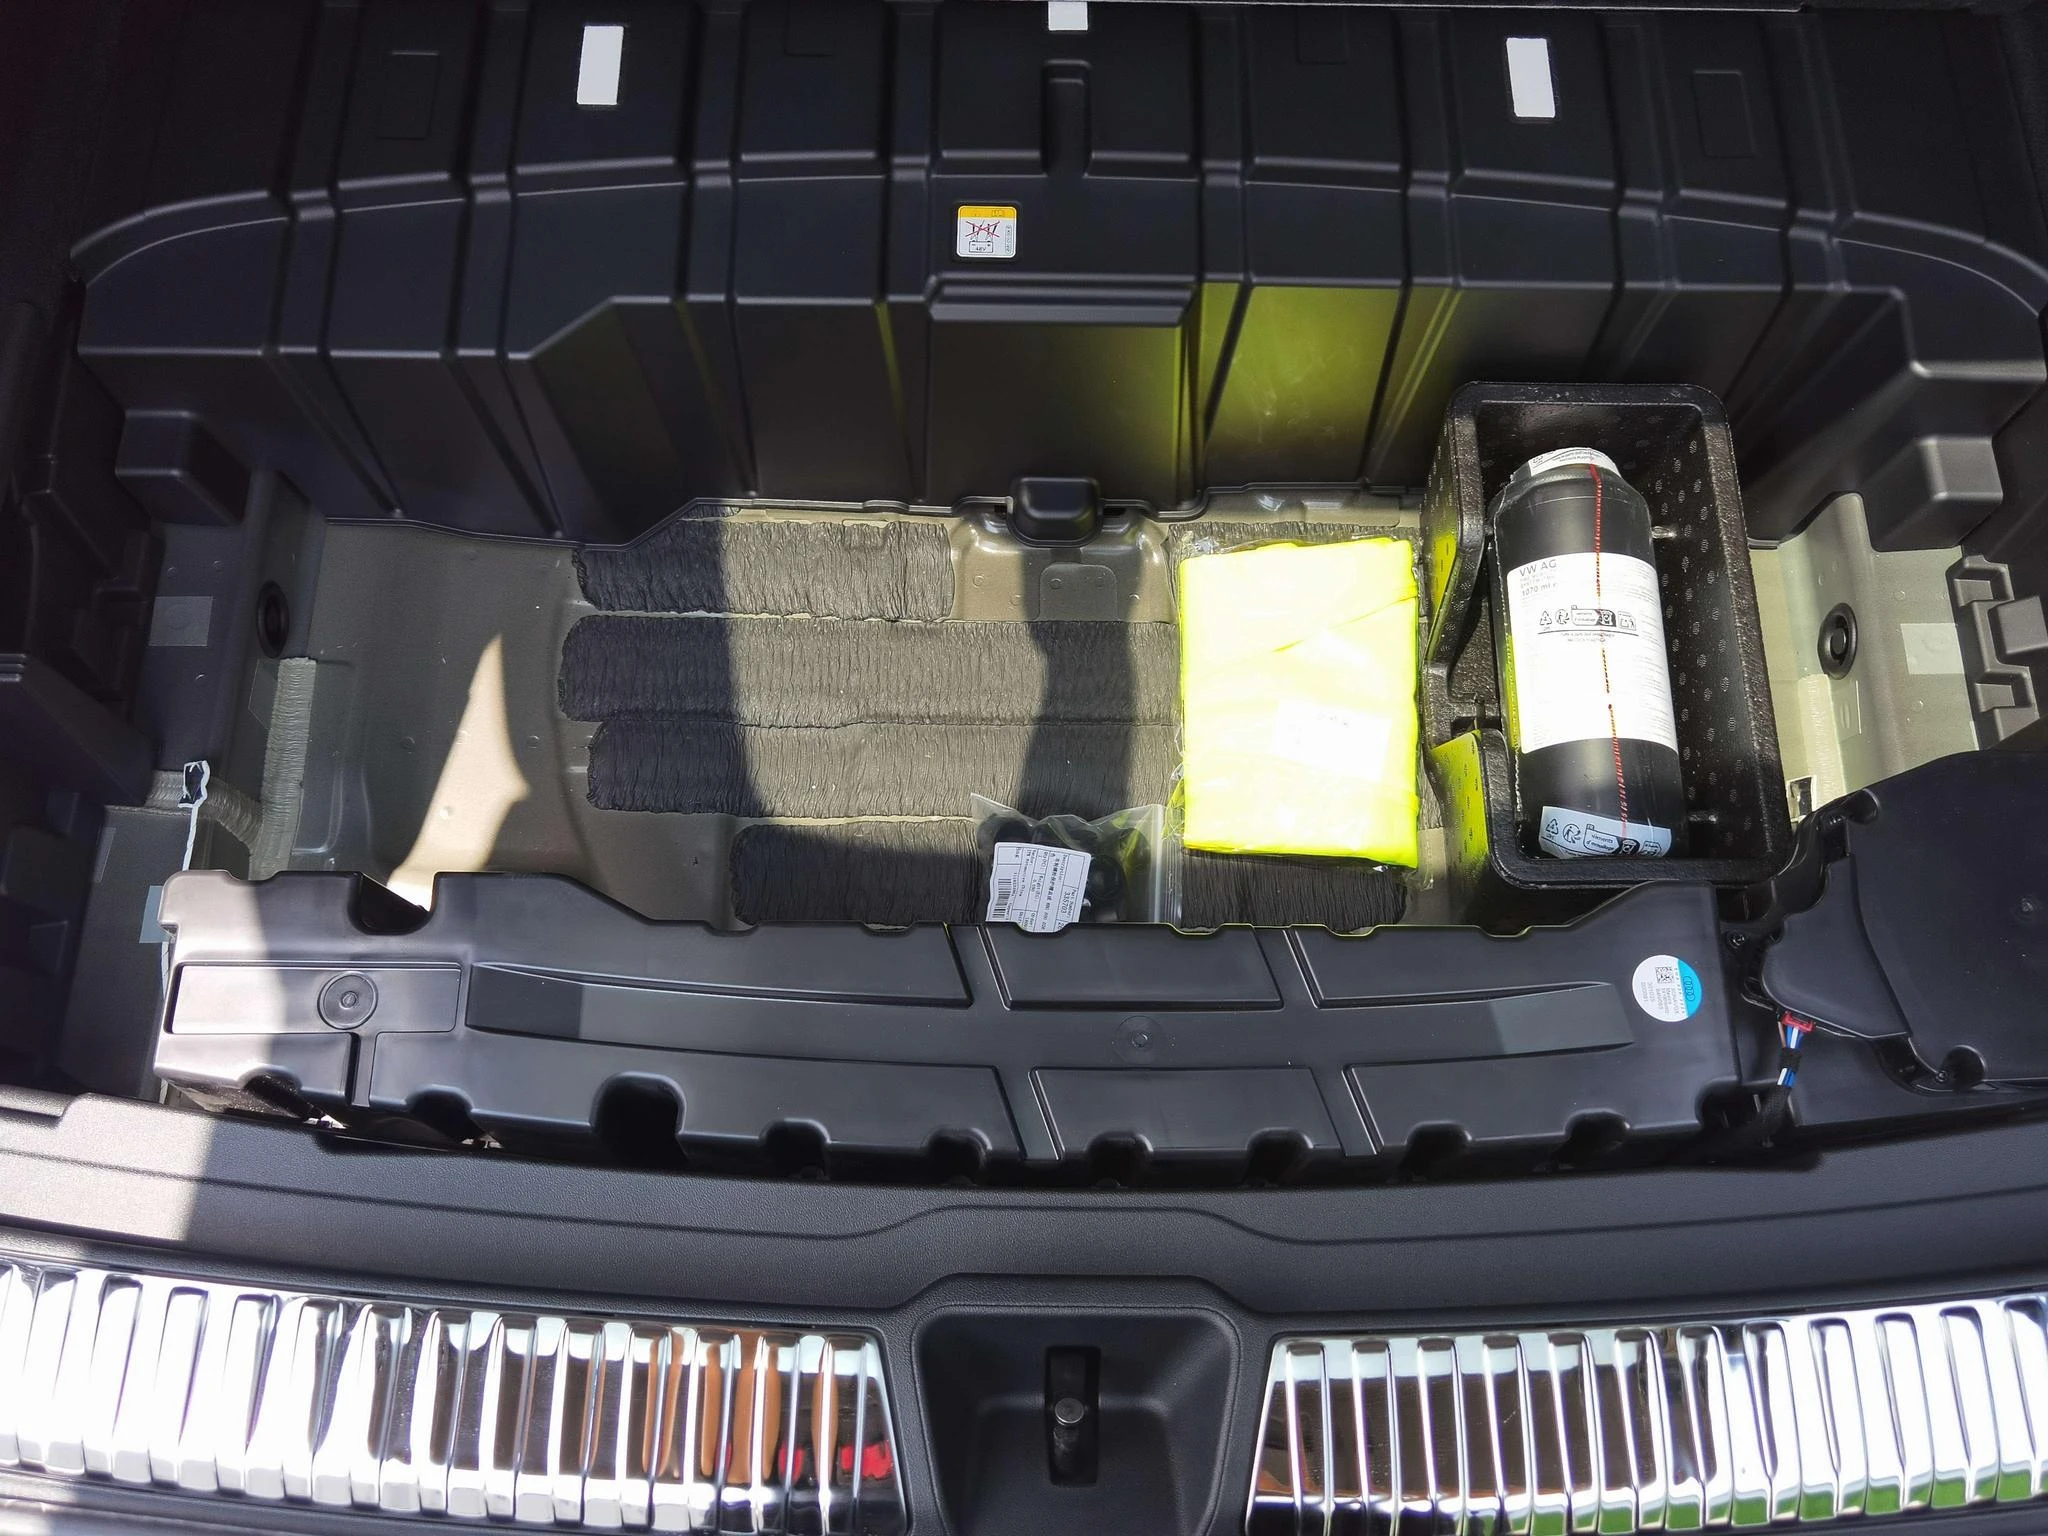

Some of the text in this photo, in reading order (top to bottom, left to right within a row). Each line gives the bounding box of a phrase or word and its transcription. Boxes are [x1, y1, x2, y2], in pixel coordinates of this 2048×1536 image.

[1519, 563, 1537, 576] VW
[1540, 558, 1557, 570] AG
[1061, 891, 1069, 913] 335703
